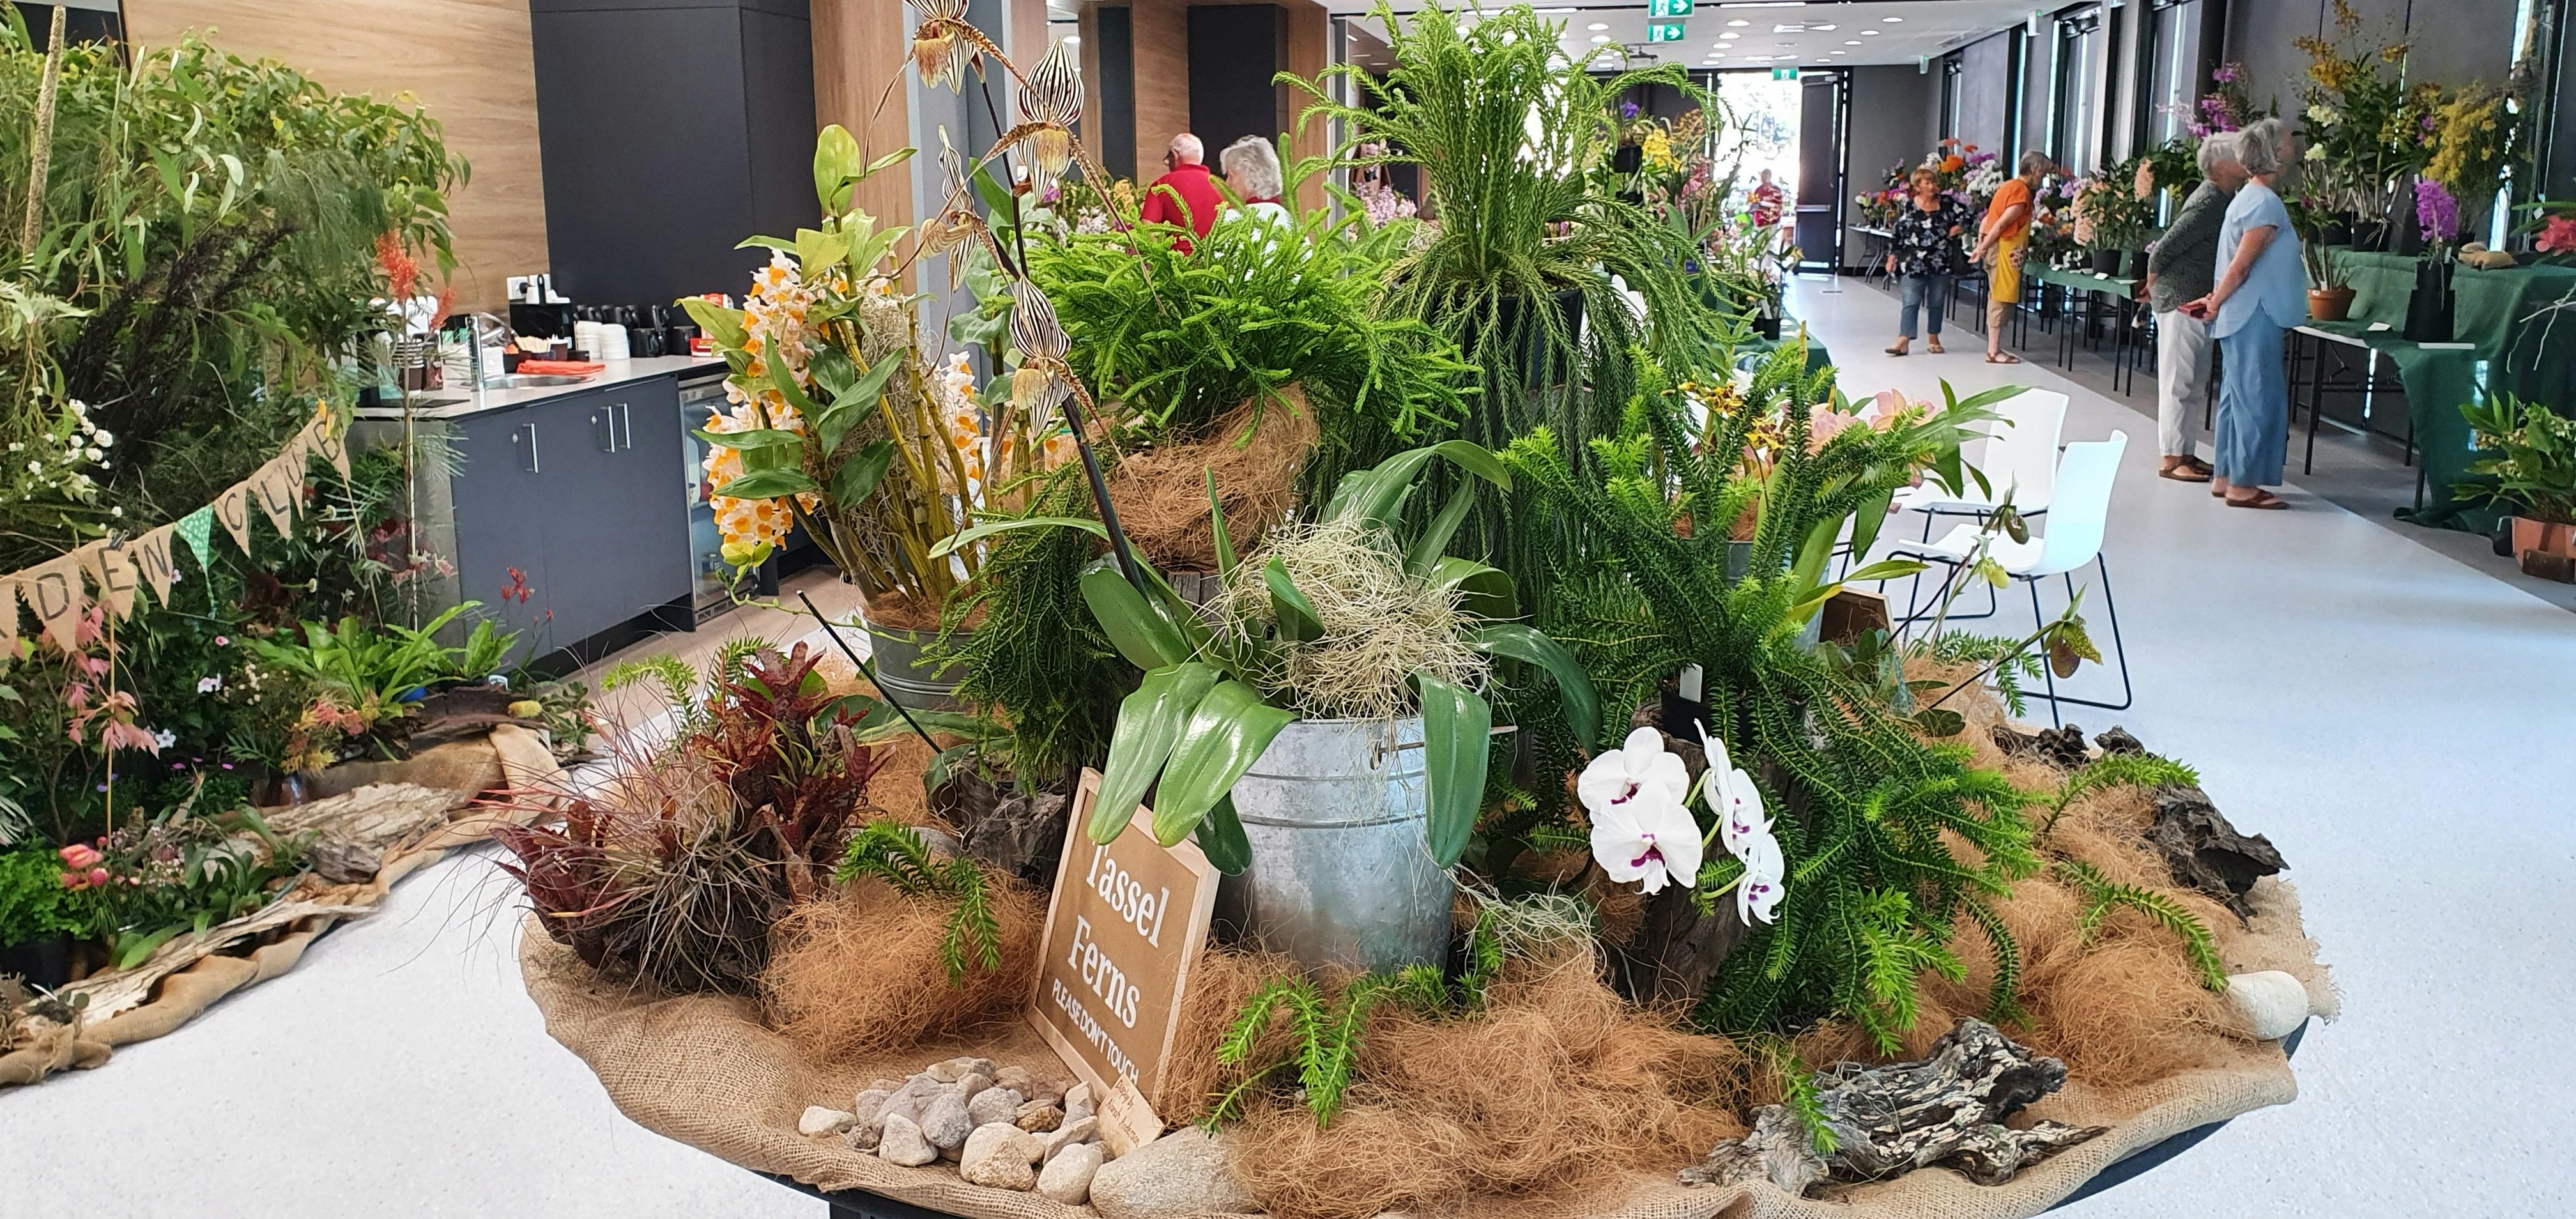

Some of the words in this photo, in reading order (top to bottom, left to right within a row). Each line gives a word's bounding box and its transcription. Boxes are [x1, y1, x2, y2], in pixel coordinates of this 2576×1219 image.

[0, 535, 171, 639] DEN
[224, 420, 341, 532] CLUB
[1085, 840, 1170, 949] Tassel
[1068, 914, 1140, 1029] Ferns
[1052, 977, 1082, 1026] PLEASE
[1080, 1009, 1108, 1054] DON'T
[1107, 1038, 1139, 1085] TOUCH
